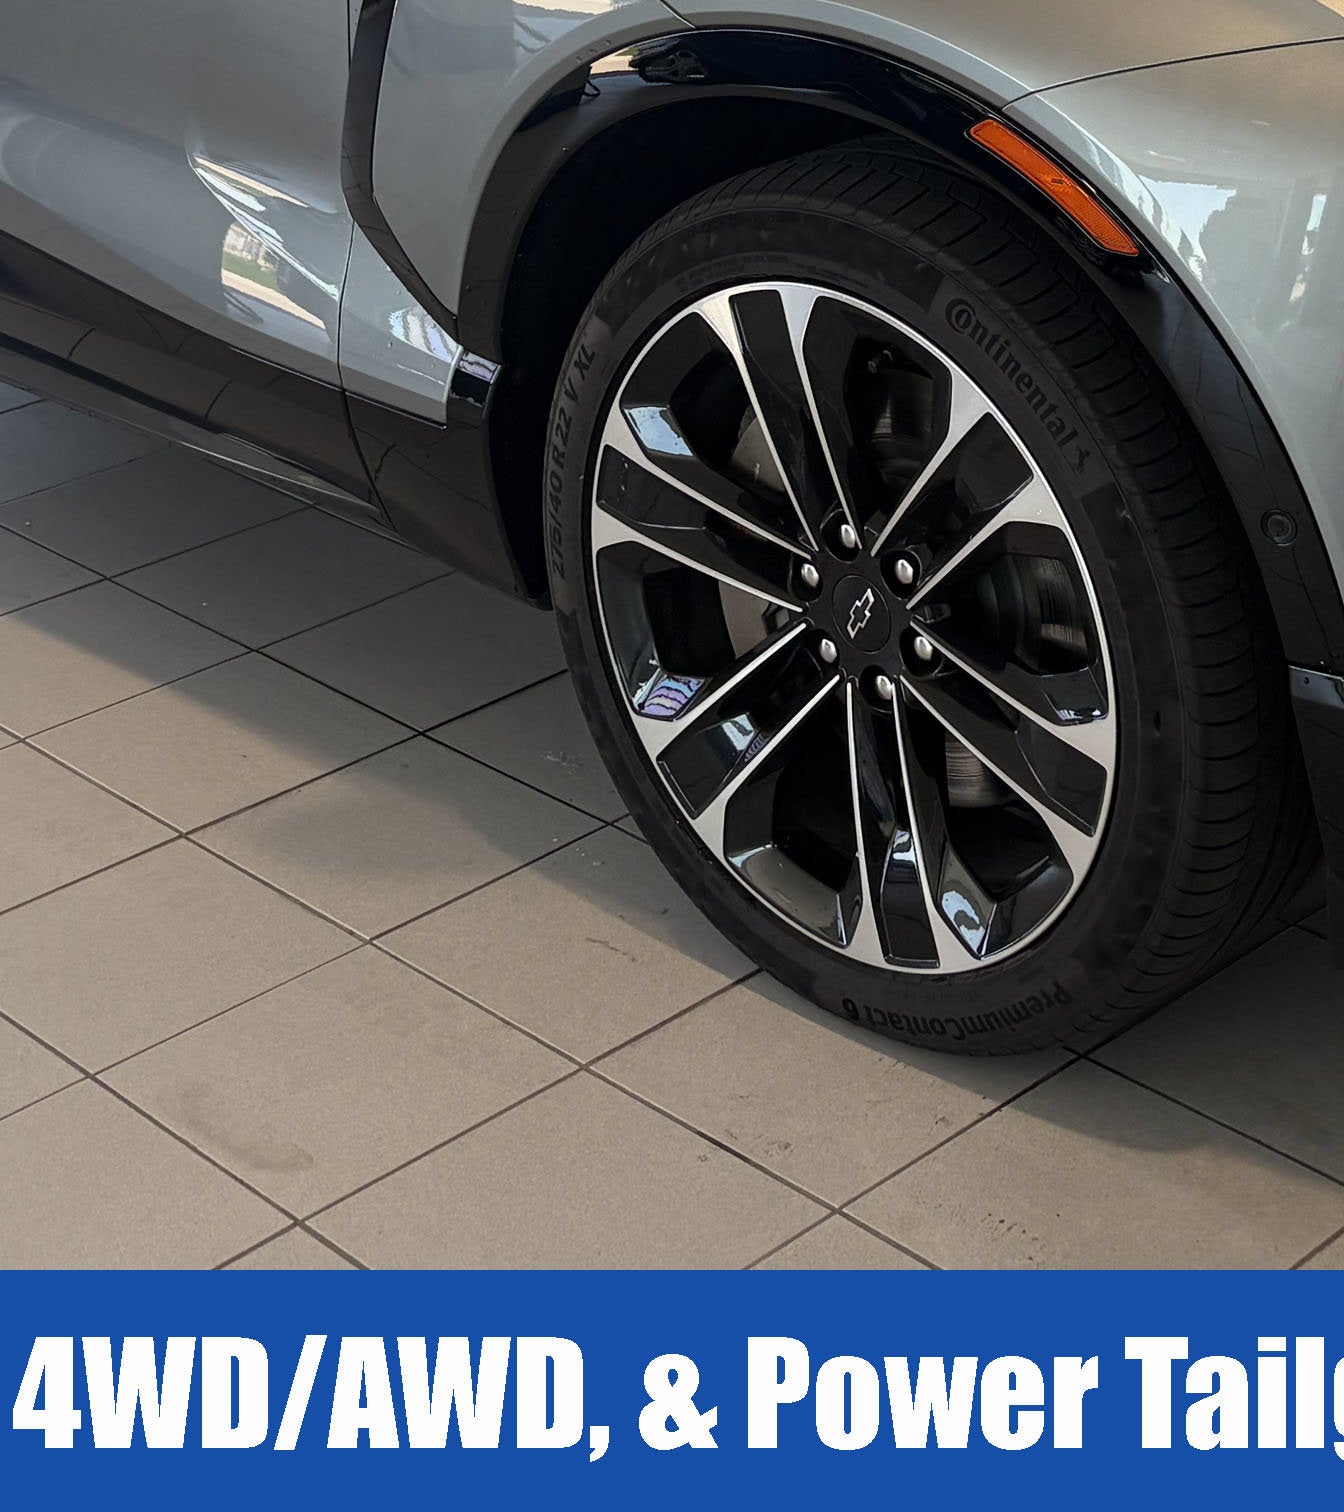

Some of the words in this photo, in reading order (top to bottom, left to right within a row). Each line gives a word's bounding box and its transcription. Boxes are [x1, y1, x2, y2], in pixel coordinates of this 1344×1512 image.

[556, 412, 573, 448] 22
[573, 343, 597, 380] XL
[944, 297, 1080, 451] Continental
[842, 997, 860, 1021] 6
[862, 981, 1074, 1041] PremiumContact
